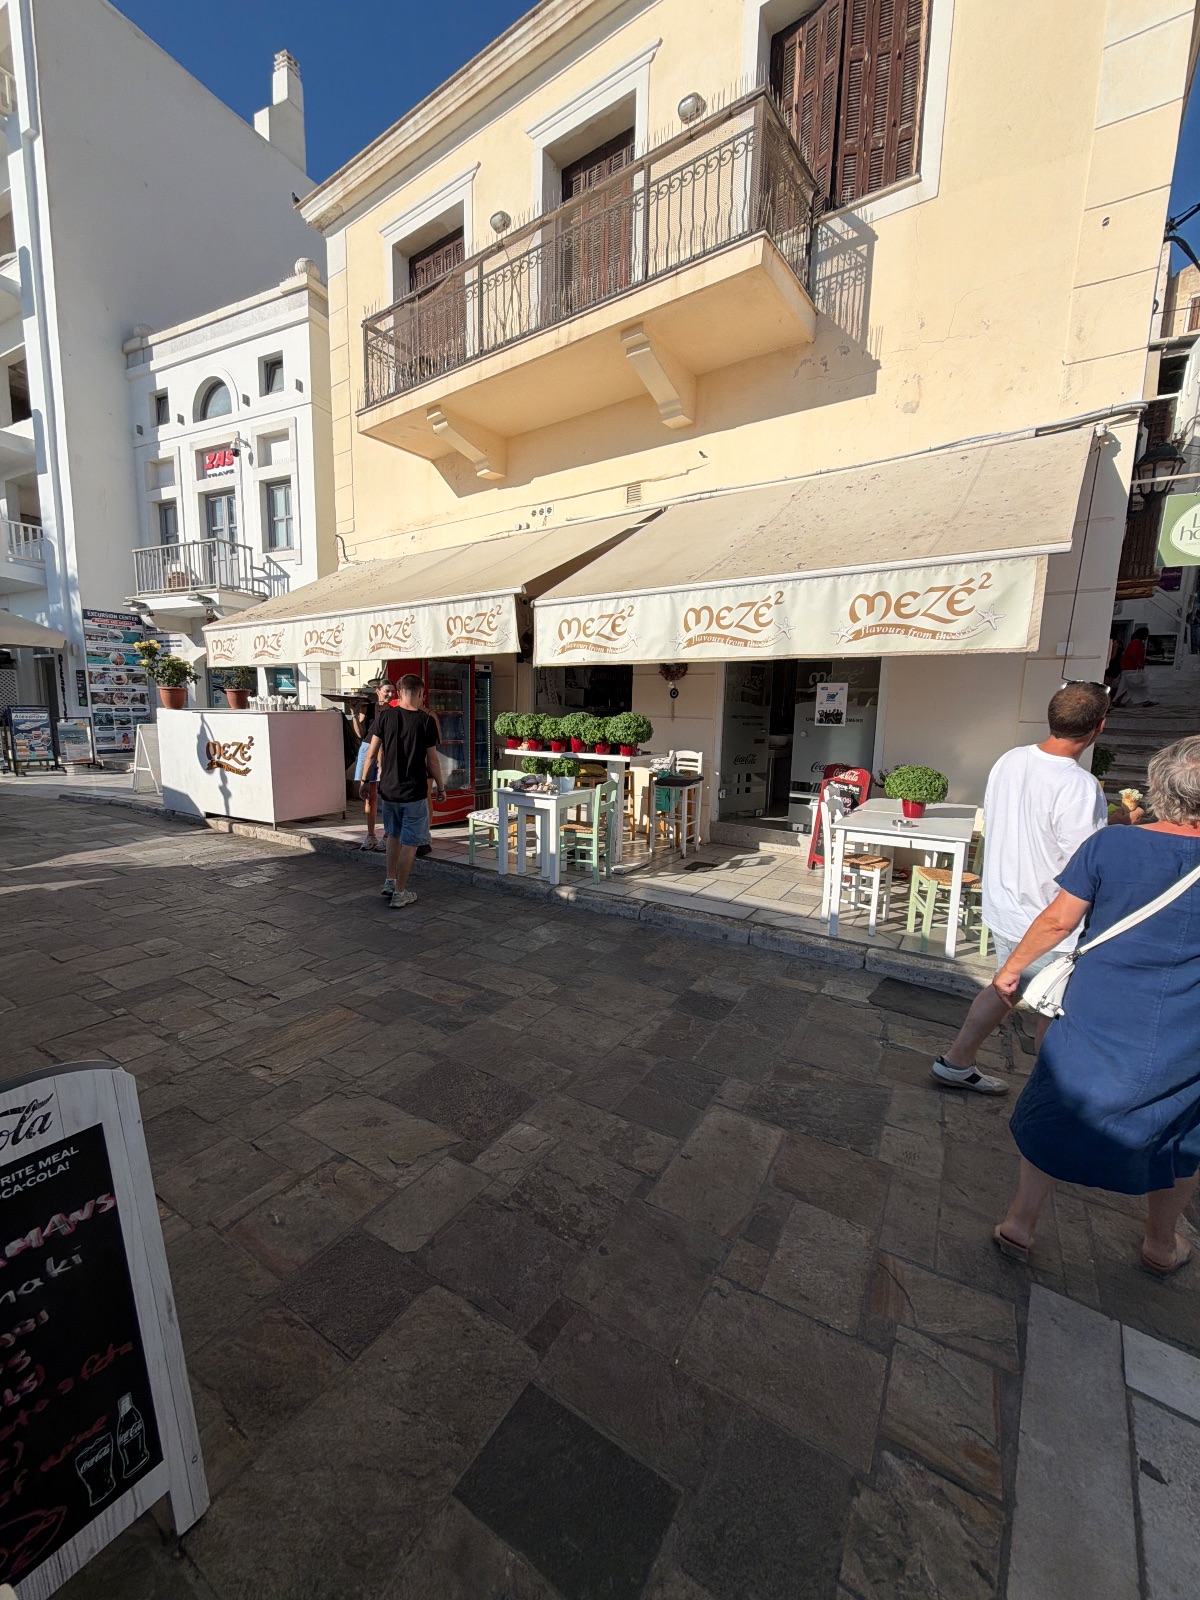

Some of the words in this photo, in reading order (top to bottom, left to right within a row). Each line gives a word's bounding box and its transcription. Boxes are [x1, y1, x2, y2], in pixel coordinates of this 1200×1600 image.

[205, 449, 235, 470] ZAS
[118, 614, 139, 622] CENTER
[860, 624, 905, 638] flavours
[906, 627, 933, 640] from
[691, 635, 724, 645] flavours
[725, 636, 745, 647] from
[833, 768, 861, 783] Coca-Cola
[38, 1146, 80, 1170] MEAL
